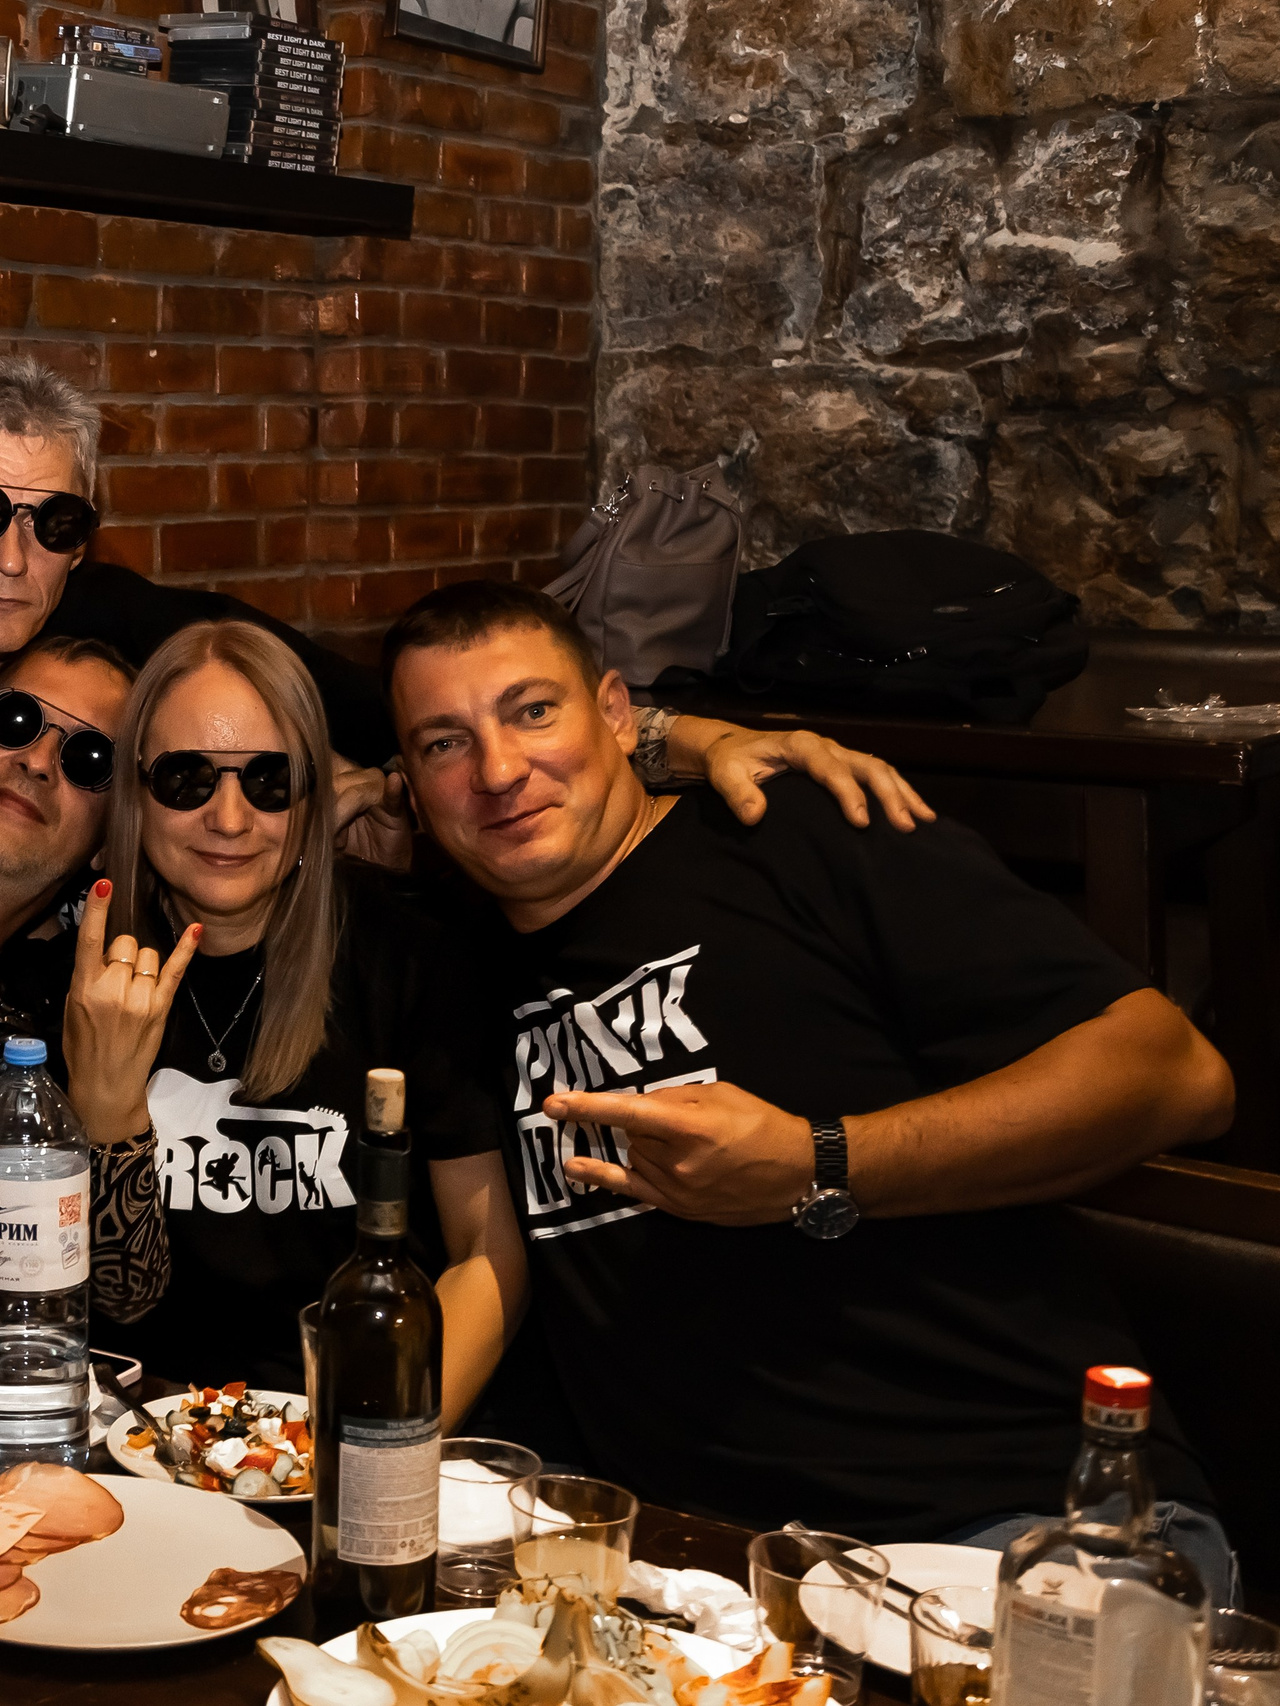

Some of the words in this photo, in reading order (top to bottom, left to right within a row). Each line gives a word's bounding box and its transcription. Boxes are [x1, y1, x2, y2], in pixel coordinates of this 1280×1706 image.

[268, 32, 282, 40] BEST
[284, 35, 302, 44] LIGHT
[309, 40, 326, 48] DARK
[278, 44, 292, 54] BEST
[293, 47, 310, 57] LIGHT
[316, 52, 332, 61] DARK
[311, 63, 324, 71] DARK
[275, 68, 289, 76] BEST
[290, 70, 307, 80] LIGHT
[308, 86, 320, 94] DARK
[292, 105, 305, 113] LIGHT
[311, 108, 323, 116] DARK
[288, 117, 302, 125] LIGHT
[307, 120, 319, 128] DARK
[286, 128, 301, 136] LIGHT
[306, 131, 319, 140] DARK
[302, 154, 315, 162] DARK
[268, 160, 280, 168] BEST
[281, 161, 296, 170] LIGHT
[302, 164, 315, 173] DARK
[513, 944, 709, 1111] PUNK
[154, 1129, 357, 1214] ROCK
